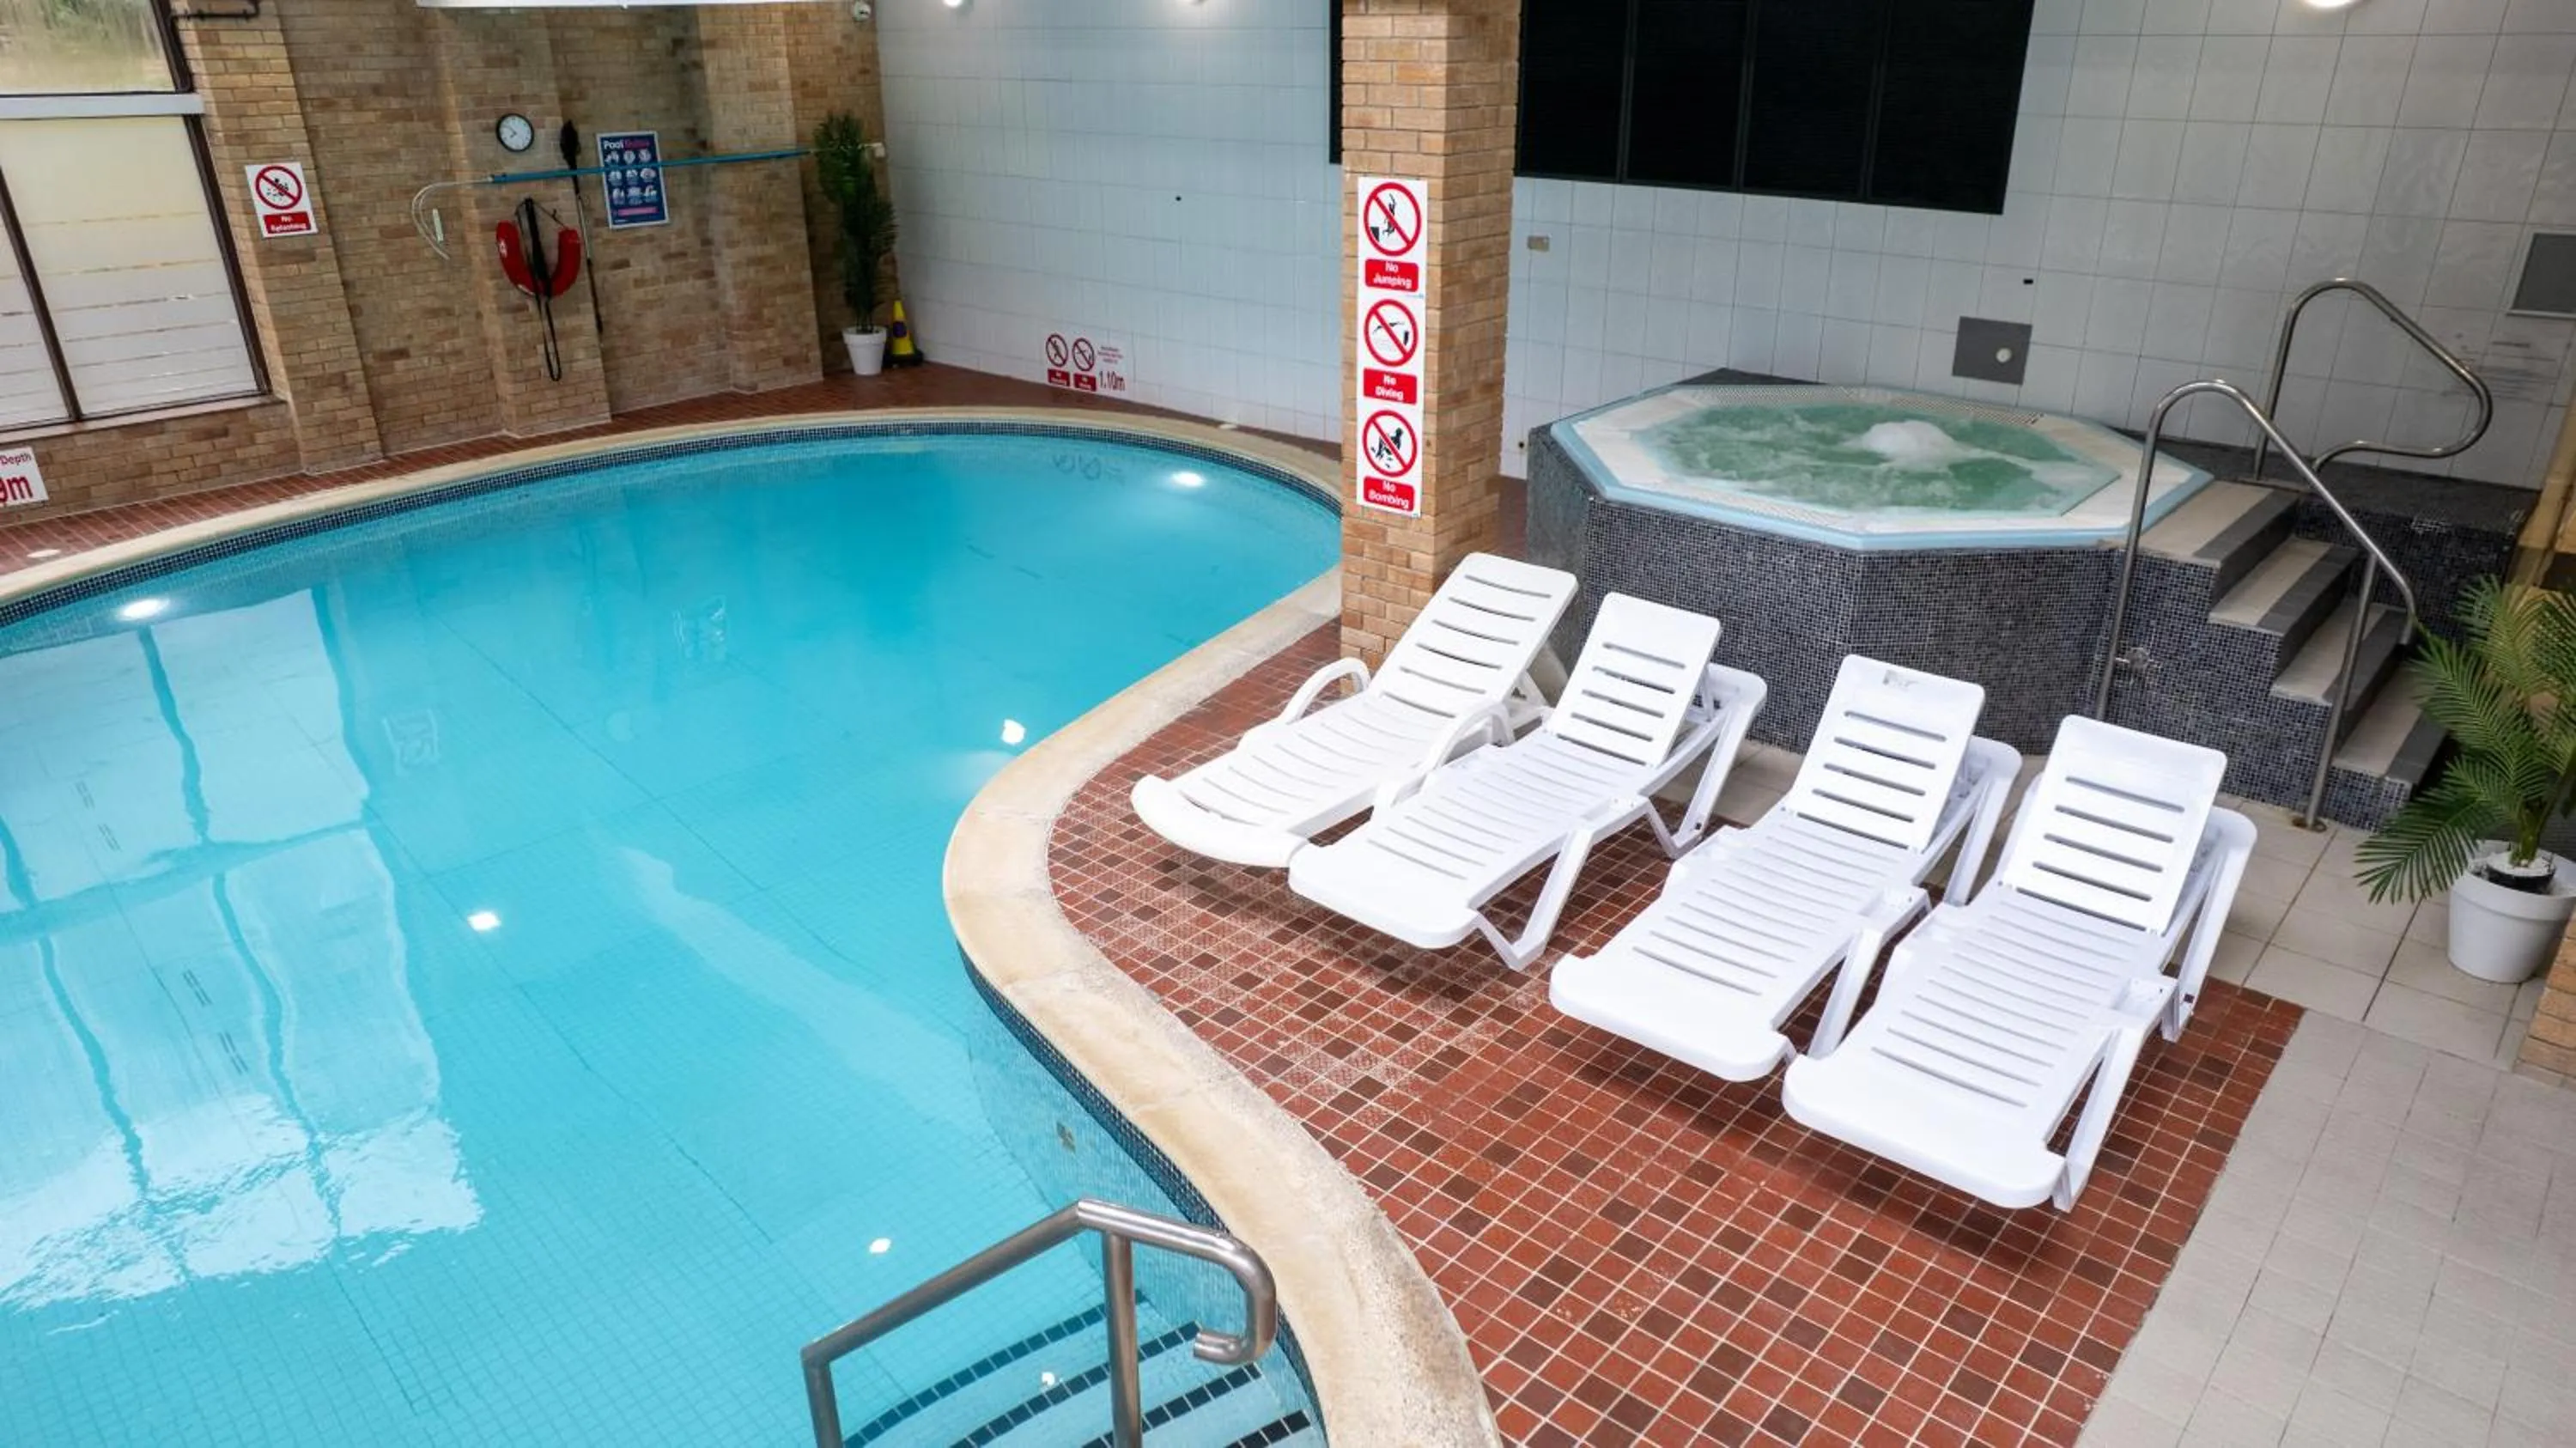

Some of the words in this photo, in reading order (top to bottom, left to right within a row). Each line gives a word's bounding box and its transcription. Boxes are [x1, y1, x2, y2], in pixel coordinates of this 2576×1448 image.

[604, 140, 623, 149] Pool
[1385, 261, 1399, 273] No
[1373, 272, 1413, 289] Jumping
[1383, 374, 1397, 386] No
[1375, 386, 1404, 401] Diving
[0, 453, 32, 465] Depth
[1382, 480, 1396, 492] No
[1368, 489, 1409, 509] Bombing
